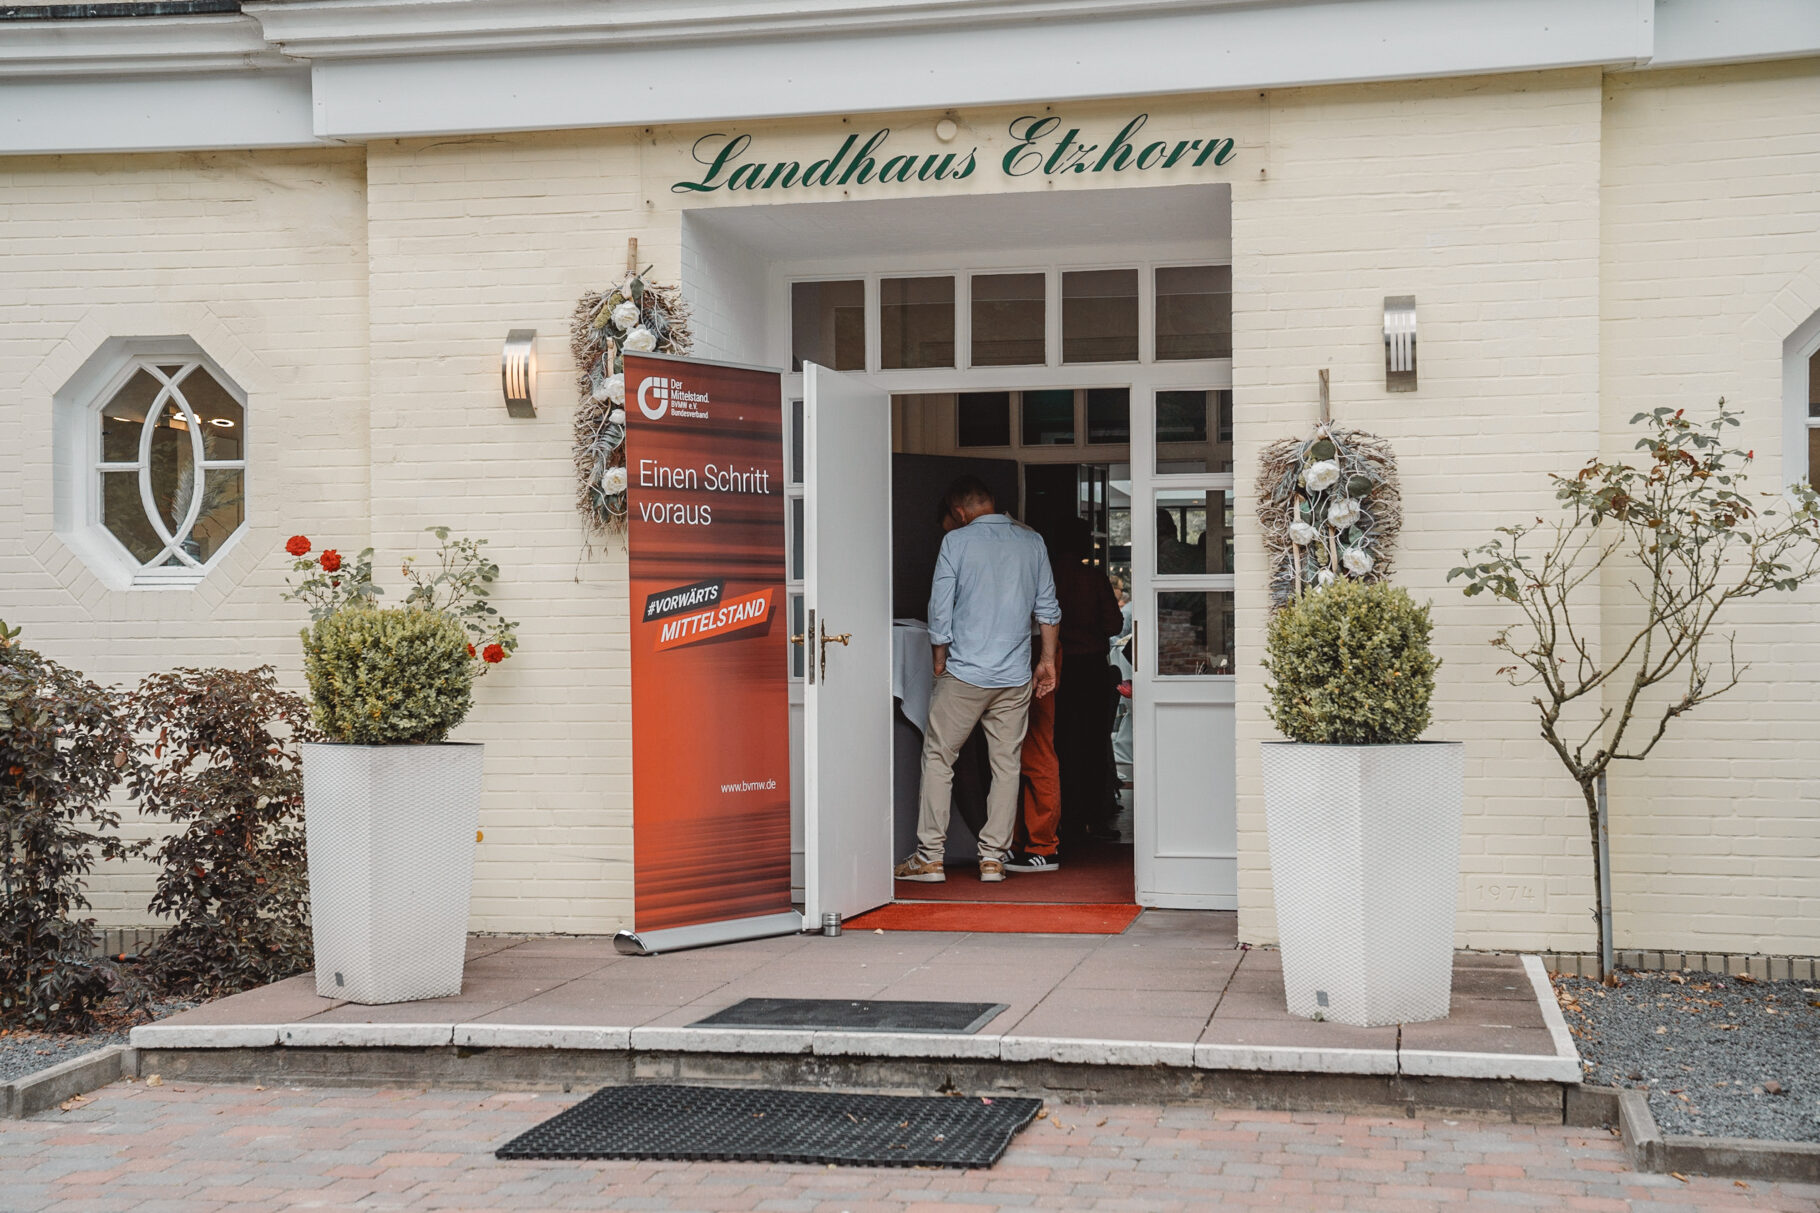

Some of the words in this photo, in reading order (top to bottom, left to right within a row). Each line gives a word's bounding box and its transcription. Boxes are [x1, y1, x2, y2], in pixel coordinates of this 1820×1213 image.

[671, 128, 977, 193] Landhaus
[1002, 114, 1237, 176] Etzhorn
[670, 378, 683, 390] Der
[670, 408, 709, 419] Bundesverband
[640, 459, 697, 489] Einen
[704, 464, 770, 494] Schritt
[639, 502, 712, 525] voraus
[647, 585, 719, 616] #VORWÄRTS
[660, 598, 766, 643] MITTELSTAND
[720, 779, 776, 793] www.bvmw.de
[1475, 884, 1536, 901] 1974
